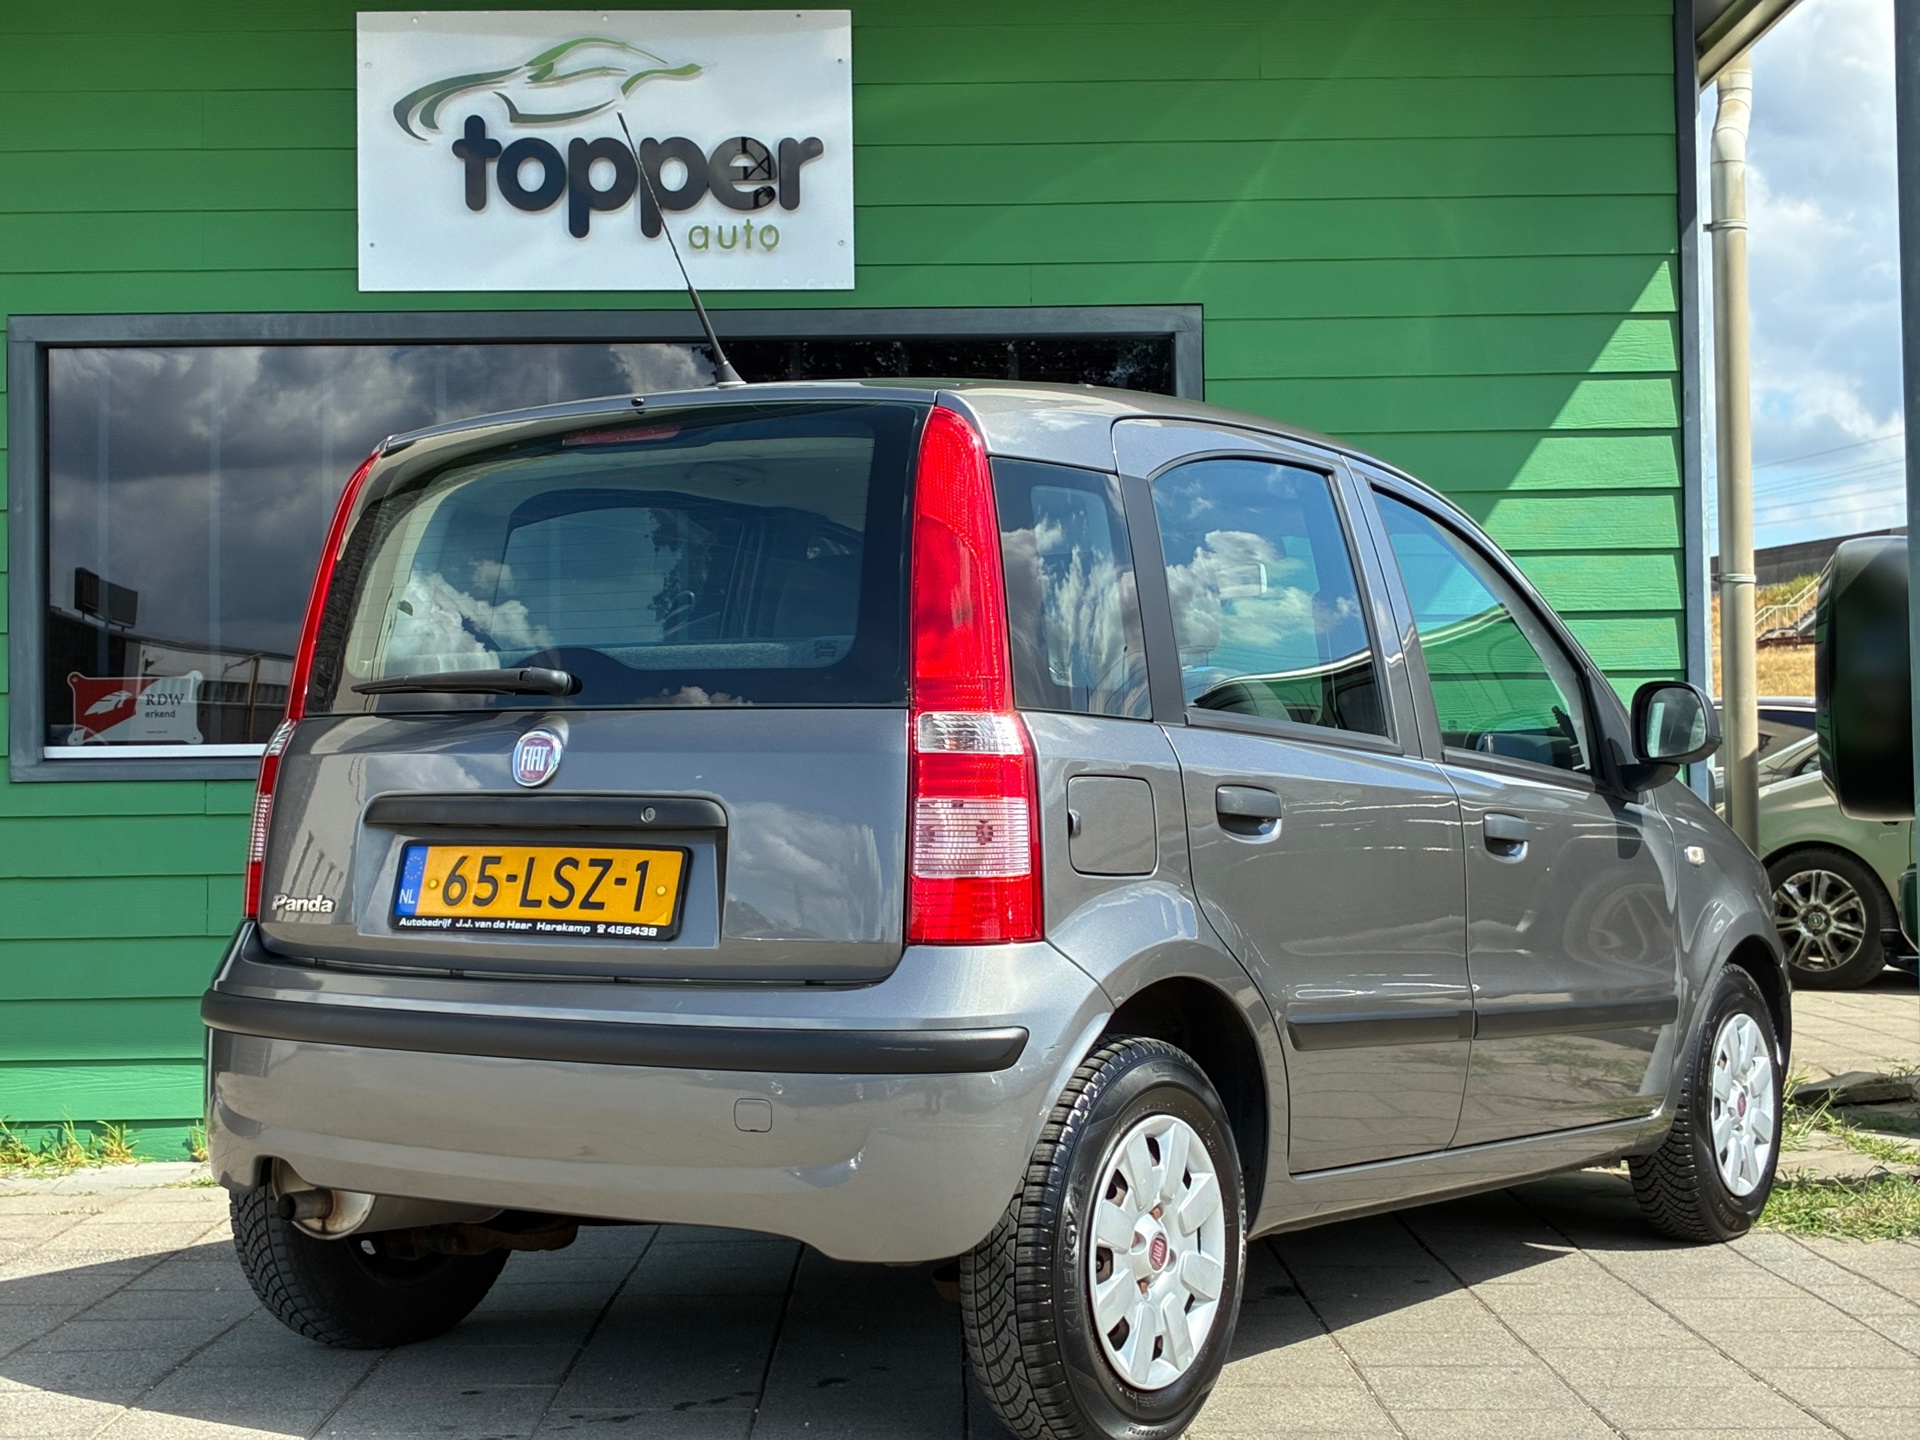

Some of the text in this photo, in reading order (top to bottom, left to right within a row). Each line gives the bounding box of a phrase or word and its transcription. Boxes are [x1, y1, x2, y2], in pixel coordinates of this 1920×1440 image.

[452, 115, 824, 239] topper
[689, 219, 780, 250] auto
[146, 693, 185, 706] RDW
[145, 709, 176, 718] erkend
[520, 745, 551, 771] FIAT
[442, 856, 650, 912] 65-LSZ-1
[271, 894, 334, 913] Panda
[399, 888, 416, 904] NL
[399, 917, 658, 937] Autobedrijf J.J. van de Haar Harskamp 456438
[1152, 1239, 1165, 1264] FIAT
